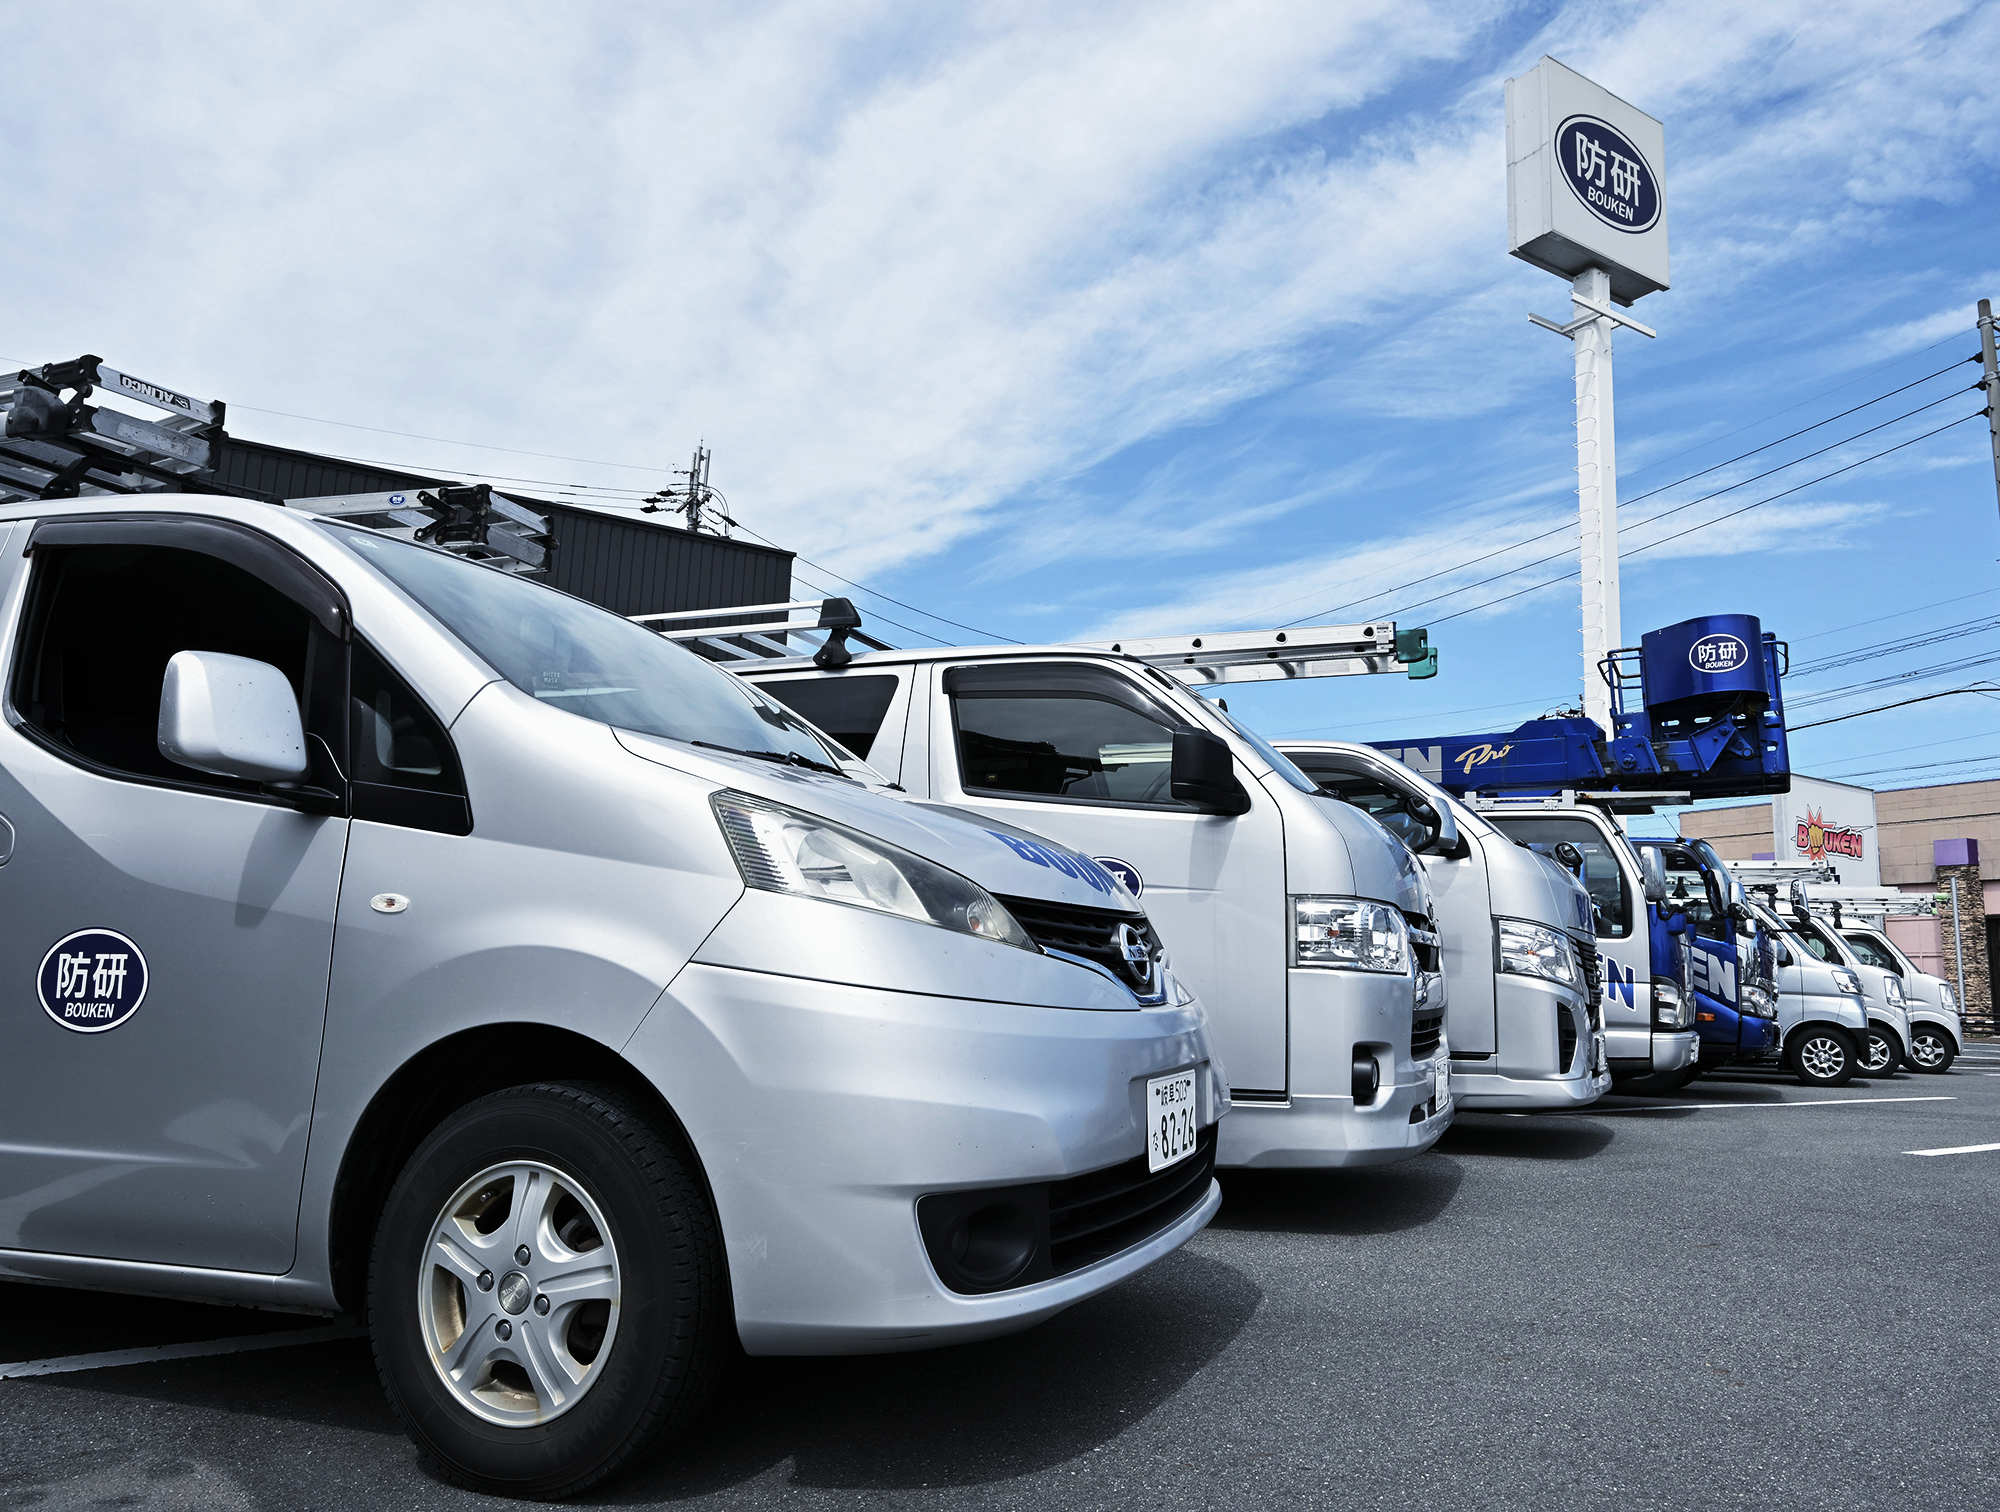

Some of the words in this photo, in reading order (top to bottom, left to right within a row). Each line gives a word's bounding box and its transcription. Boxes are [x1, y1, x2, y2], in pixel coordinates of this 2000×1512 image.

[1575, 130, 1641, 207] 防研
[1587, 186, 1634, 222] BOUKEN
[122, 376, 174, 403] ALINCO
[1697, 641, 1738, 664] 防研
[1705, 660, 1734, 669] BOUKEN
[1454, 743, 1514, 775] Pro
[56, 951, 128, 1000] 防研
[65, 1002, 115, 1018] BOUKEN
[546, 1362, 641, 1465] YOKOHAMA
